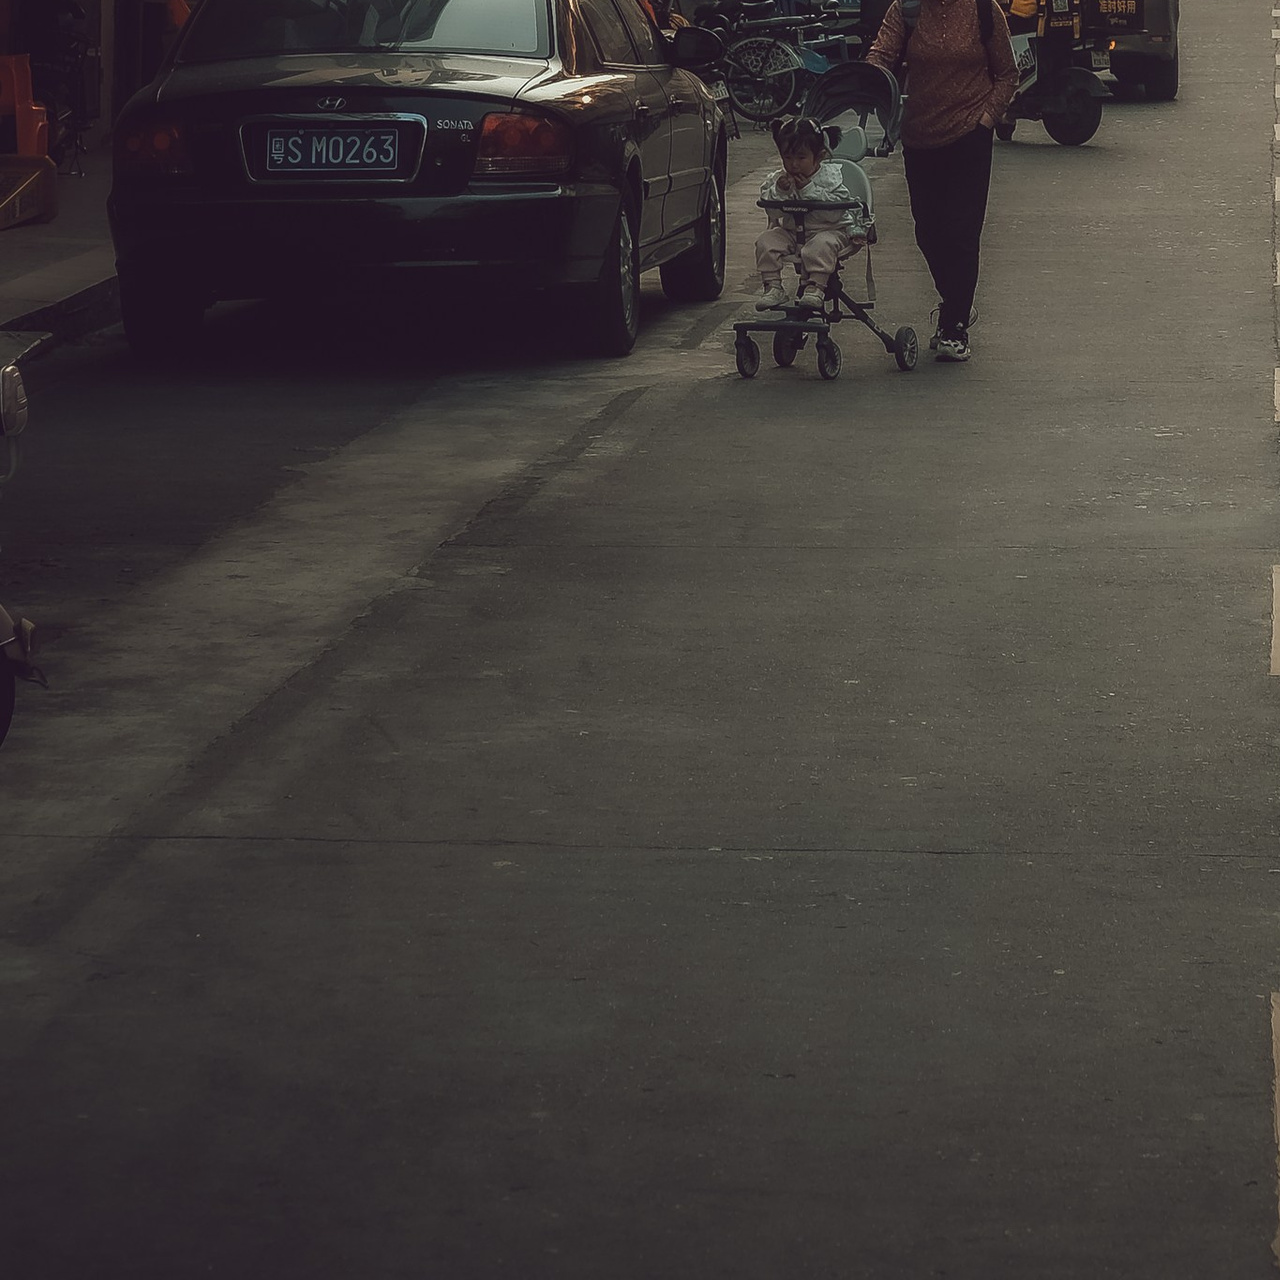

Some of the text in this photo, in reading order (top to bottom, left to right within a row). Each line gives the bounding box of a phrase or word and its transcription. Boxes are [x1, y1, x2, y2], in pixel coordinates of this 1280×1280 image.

[1098, 0, 1137, 14] 准时好用
[436, 120, 474, 130] SONATA
[460, 134, 471, 142] GL
[271, 136, 395, 165] 粤S M0263
